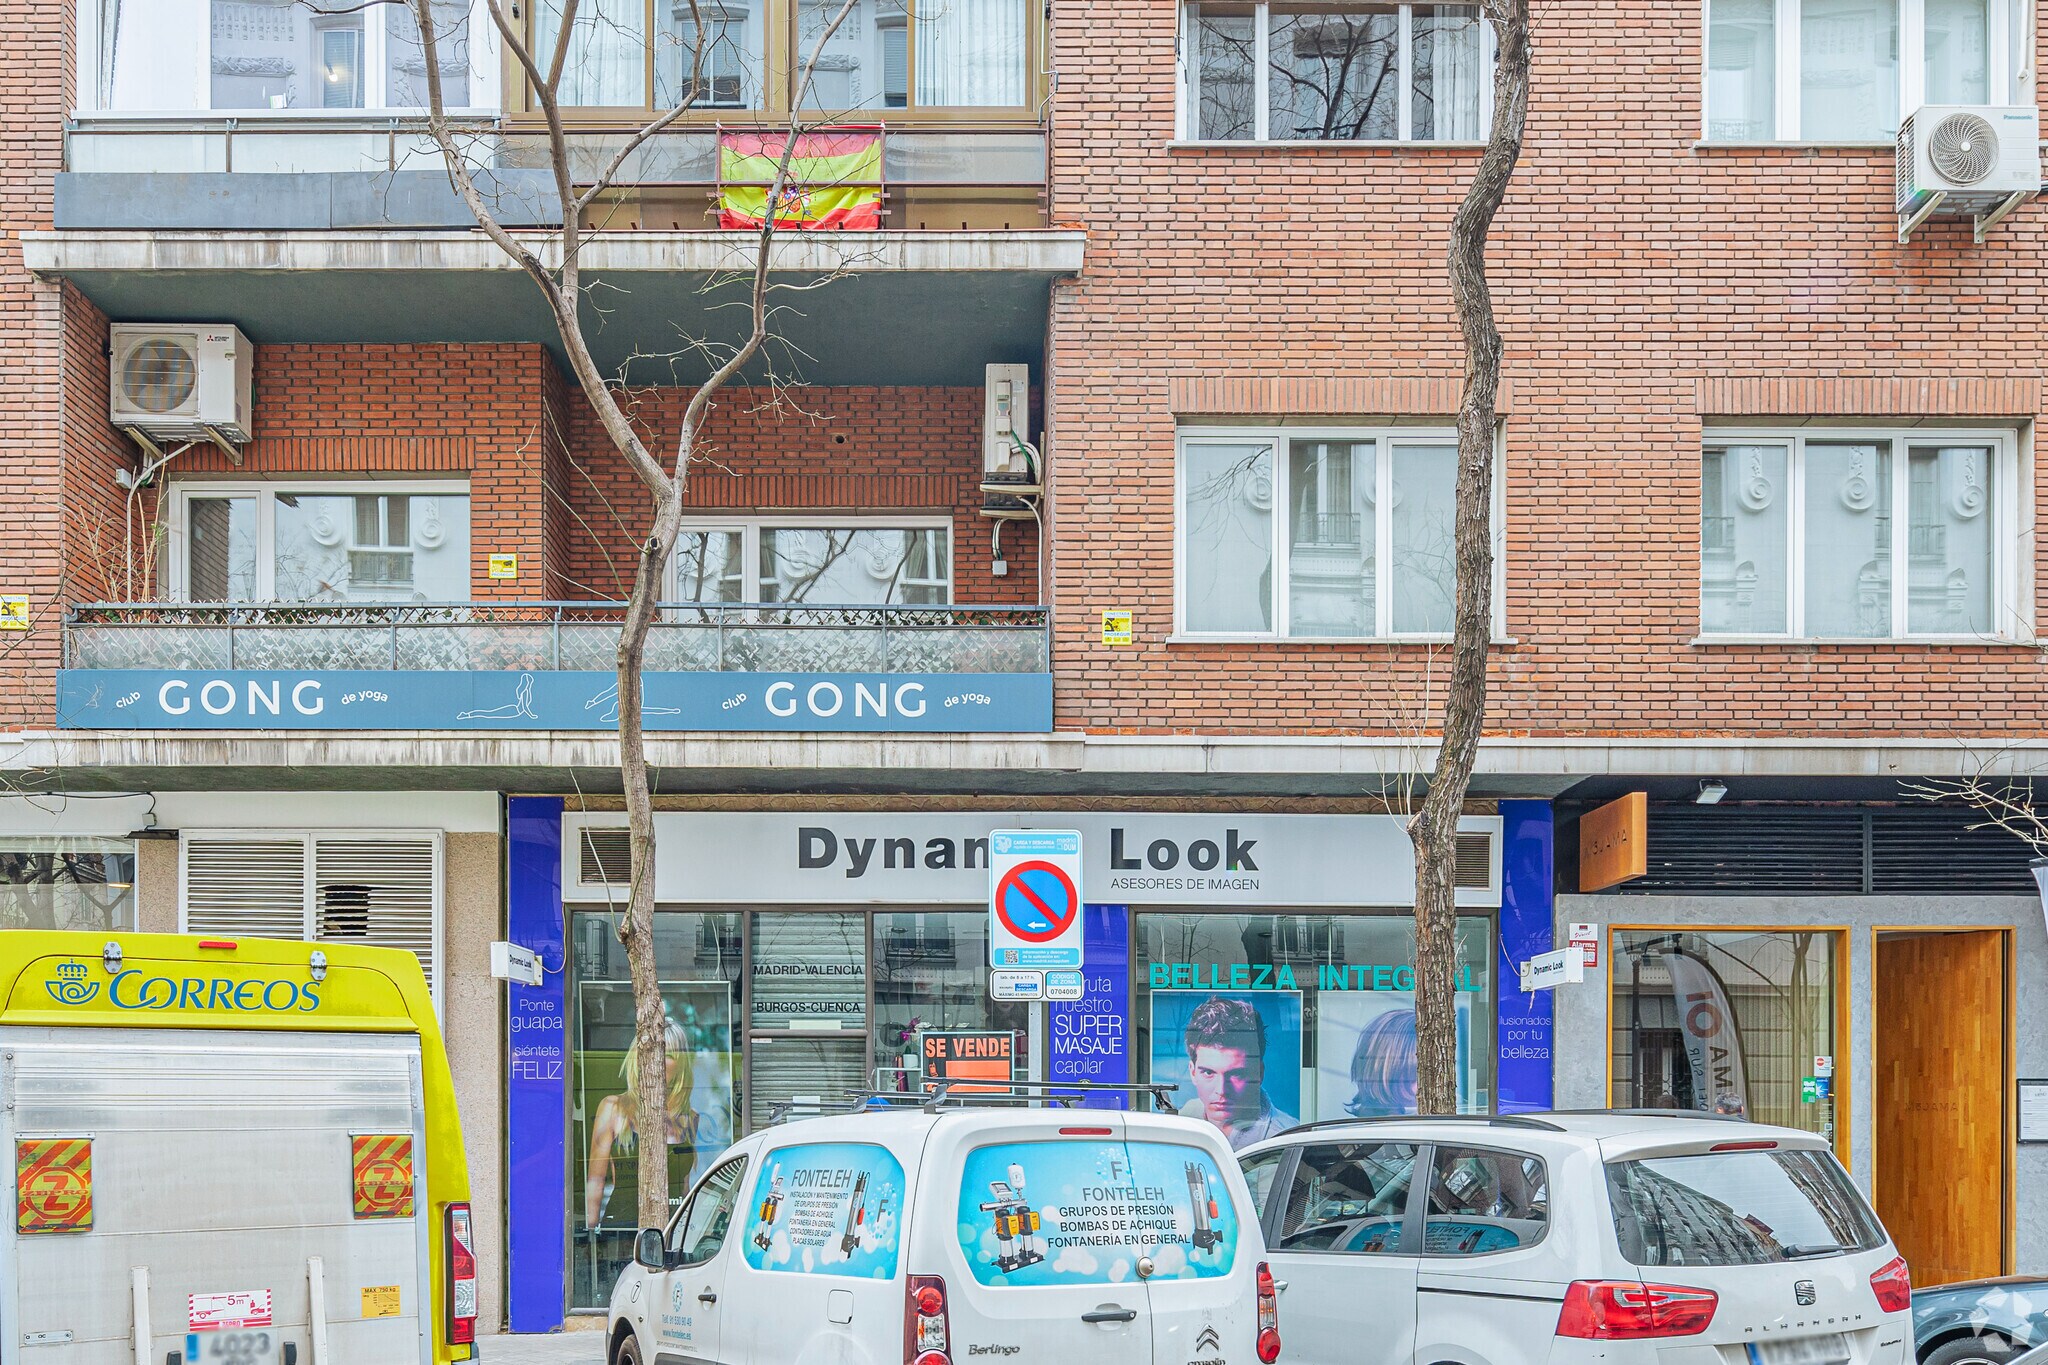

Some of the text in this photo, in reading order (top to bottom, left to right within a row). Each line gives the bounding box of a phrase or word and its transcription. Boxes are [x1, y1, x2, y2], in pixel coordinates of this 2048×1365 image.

[116, 680, 388, 715] club GONG de yoga
[722, 682, 991, 718] club GONG de yoga
[1111, 828, 1259, 872] Look
[1111, 878, 1260, 890] ASESORES DE IMAGEN
[754, 966, 863, 975] MADRID-VALENCIA
[1534, 960, 1564, 976] Dynamic Look
[1150, 964, 1298, 990] BELLEZA
[108, 968, 320, 1012] CORREOS
[520, 998, 554, 1012] Ponte
[756, 1002, 860, 1012] BURGOS-CUENCA
[1055, 996, 1113, 1012] nuestro
[510, 1016, 563, 1033] guapa
[1055, 1014, 1122, 1036] SUPER
[1508, 1029, 1542, 1041] por tu
[514, 1045, 560, 1056] siéntete
[925, 1038, 1010, 1058] SE VENDE
[1055, 1036, 1122, 1055] MASAJE
[1501, 1045, 1549, 1059] belleza
[512, 1060, 562, 1080] FELIZ
[1055, 1057, 1104, 1077] capilar
[790, 1169, 852, 1188] FONTELEH
[1110, 1161, 1122, 1180] F
[22, 1187, 89, 1198] ZEPRO
[1082, 1187, 1165, 1202] FONTELEH
[877, 1200, 888, 1222] F
[1059, 1203, 1174, 1217] GRUPOS DE PRESIÓN
[1060, 1219, 1177, 1232] BOMBAS DE ACHIQUE
[1048, 1234, 1191, 1248] FONTANERÍA EN GENERAL
[968, 1344, 1020, 1356] Berlingo
